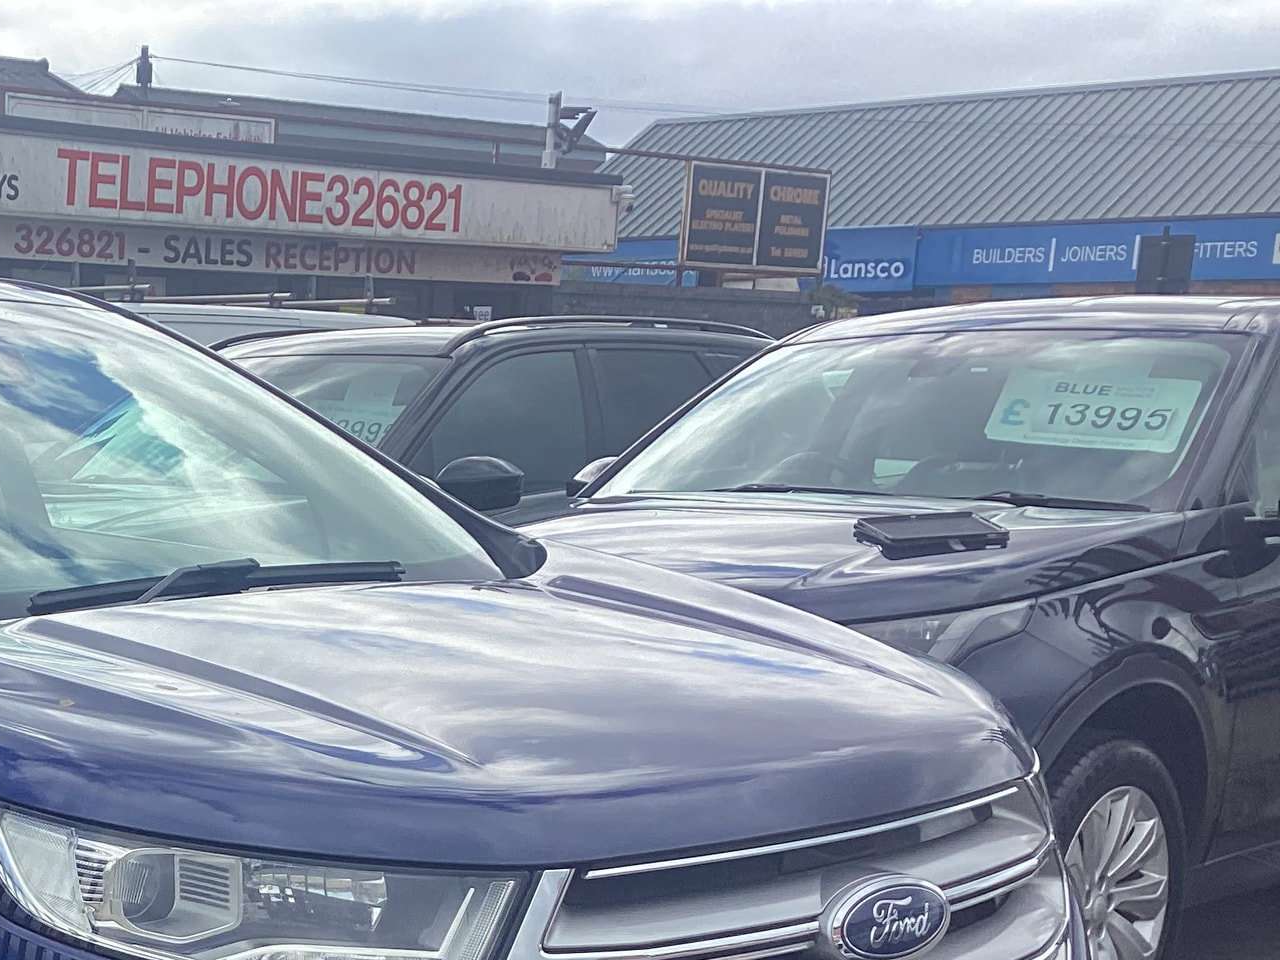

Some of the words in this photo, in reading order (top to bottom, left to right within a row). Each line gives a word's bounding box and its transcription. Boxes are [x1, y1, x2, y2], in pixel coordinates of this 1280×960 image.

[698, 179, 754, 199] QUALITY
[14, 223, 126, 260] 326821
[163, 234, 252, 267] SALES
[265, 241, 416, 274] RECEPTION
[972, 246, 1045, 265] BUILDERS
[1061, 244, 1128, 263] JOINERS
[830, 257, 904, 279] Lansco
[1055, 381, 1113, 396] BLUE
[1046, 403, 1173, 431] 13995
[870, 896, 931, 948] Ford
